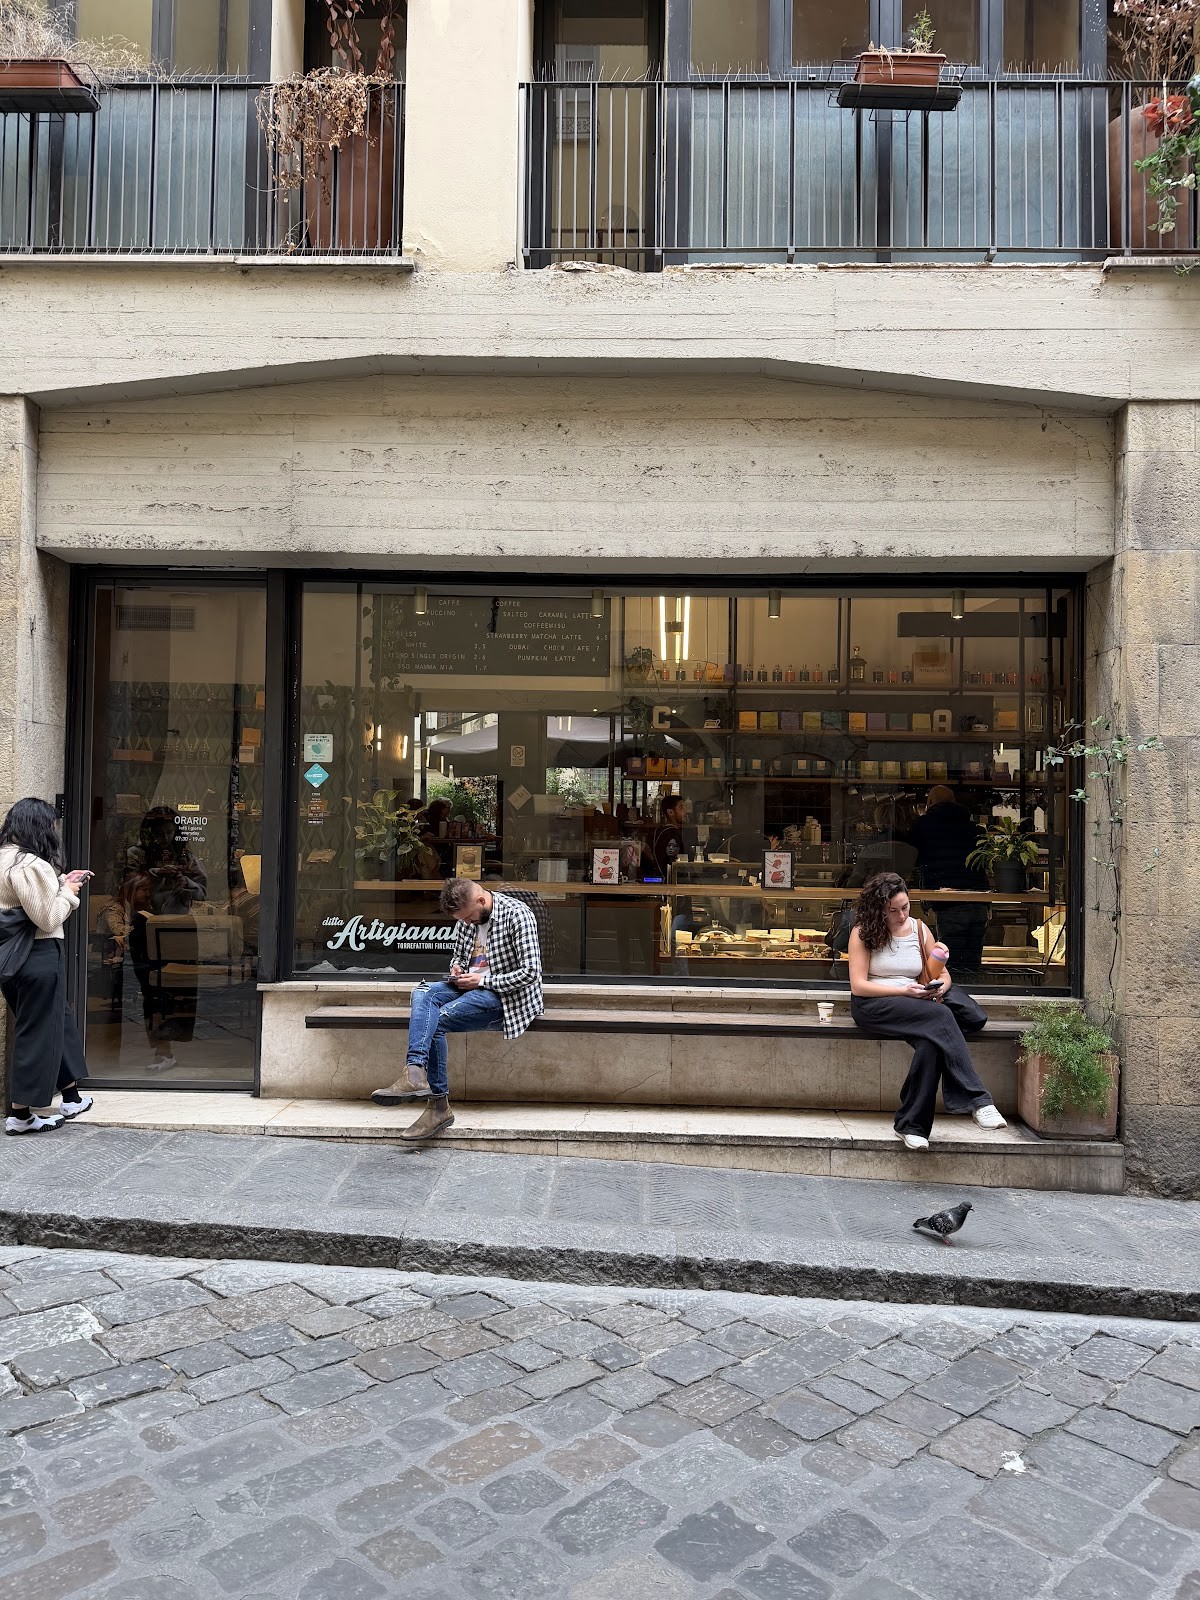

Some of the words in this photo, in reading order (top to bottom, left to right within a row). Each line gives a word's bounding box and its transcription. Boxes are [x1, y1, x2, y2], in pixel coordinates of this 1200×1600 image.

[486, 632, 528, 640] STRAWBERRY
[439, 653, 466, 661] ORIGIN
[517, 654, 548, 662] PUMPKIN
[174, 815, 208, 826] ORARIO
[322, 916, 345, 926] ditta
[396, 942, 434, 950] TORREFATTORI
[434, 942, 456, 950] FIRENZE
